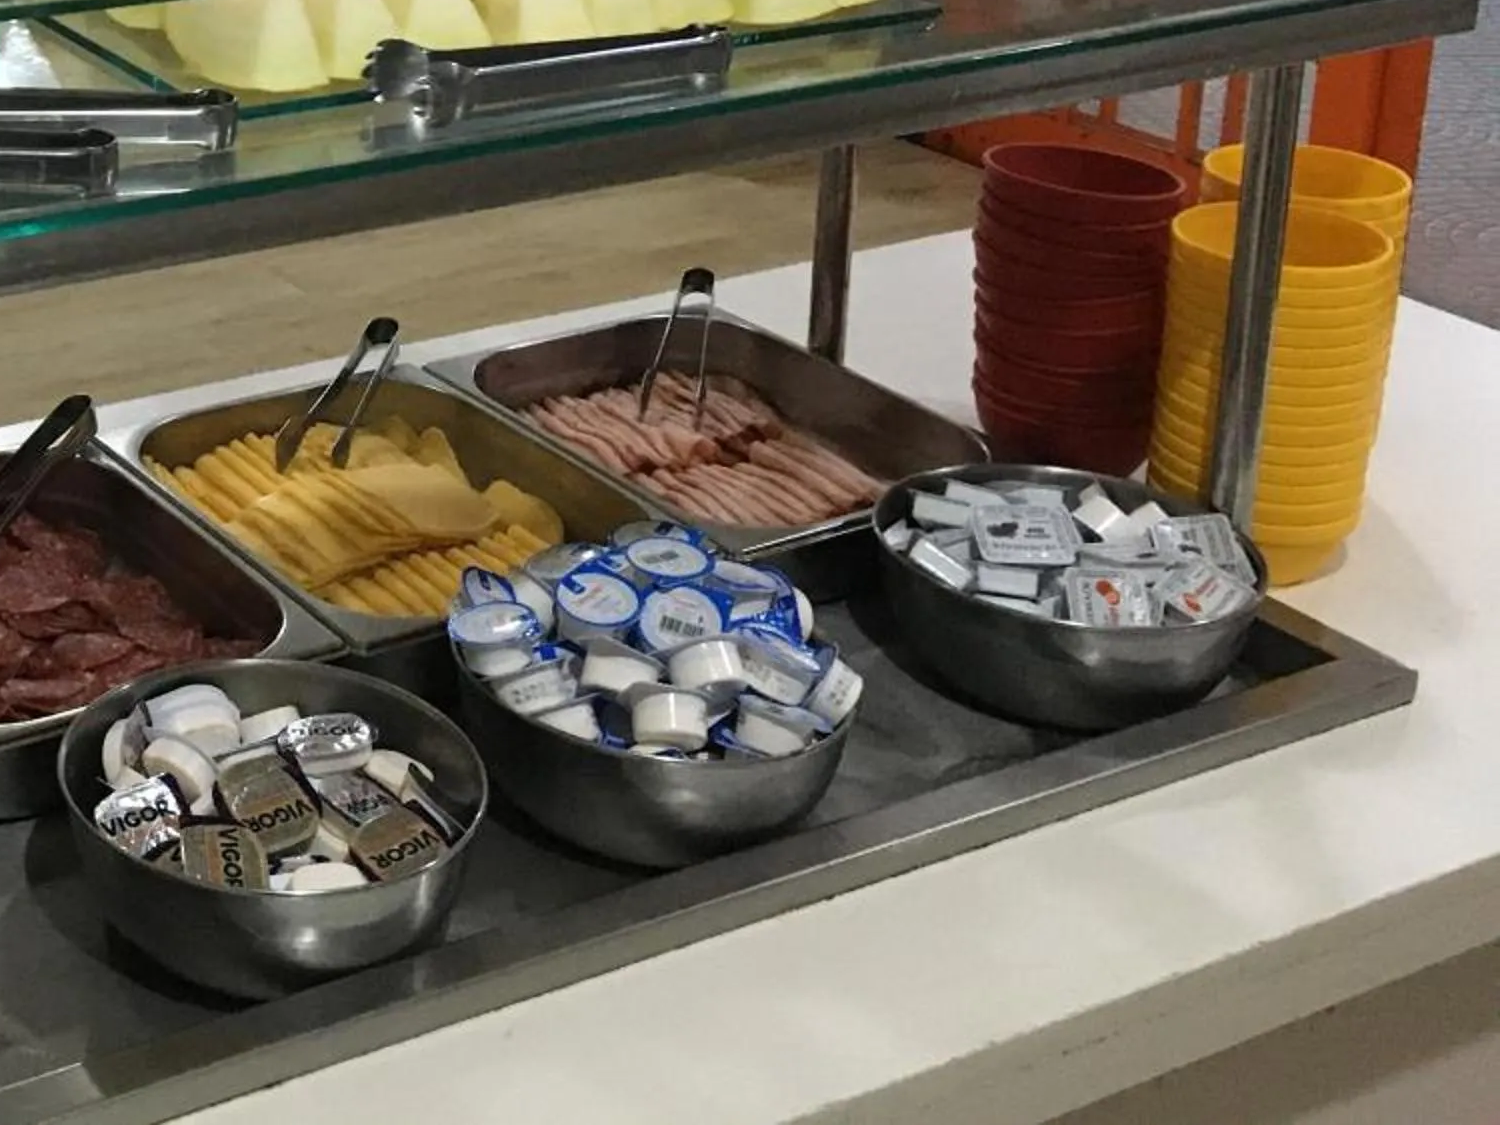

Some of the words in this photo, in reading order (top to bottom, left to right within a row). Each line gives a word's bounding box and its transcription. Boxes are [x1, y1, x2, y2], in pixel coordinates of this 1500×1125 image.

[100, 799, 176, 837] VIGOR
[242, 799, 314, 833] VIGOR
[369, 829, 440, 869] VIGOR
